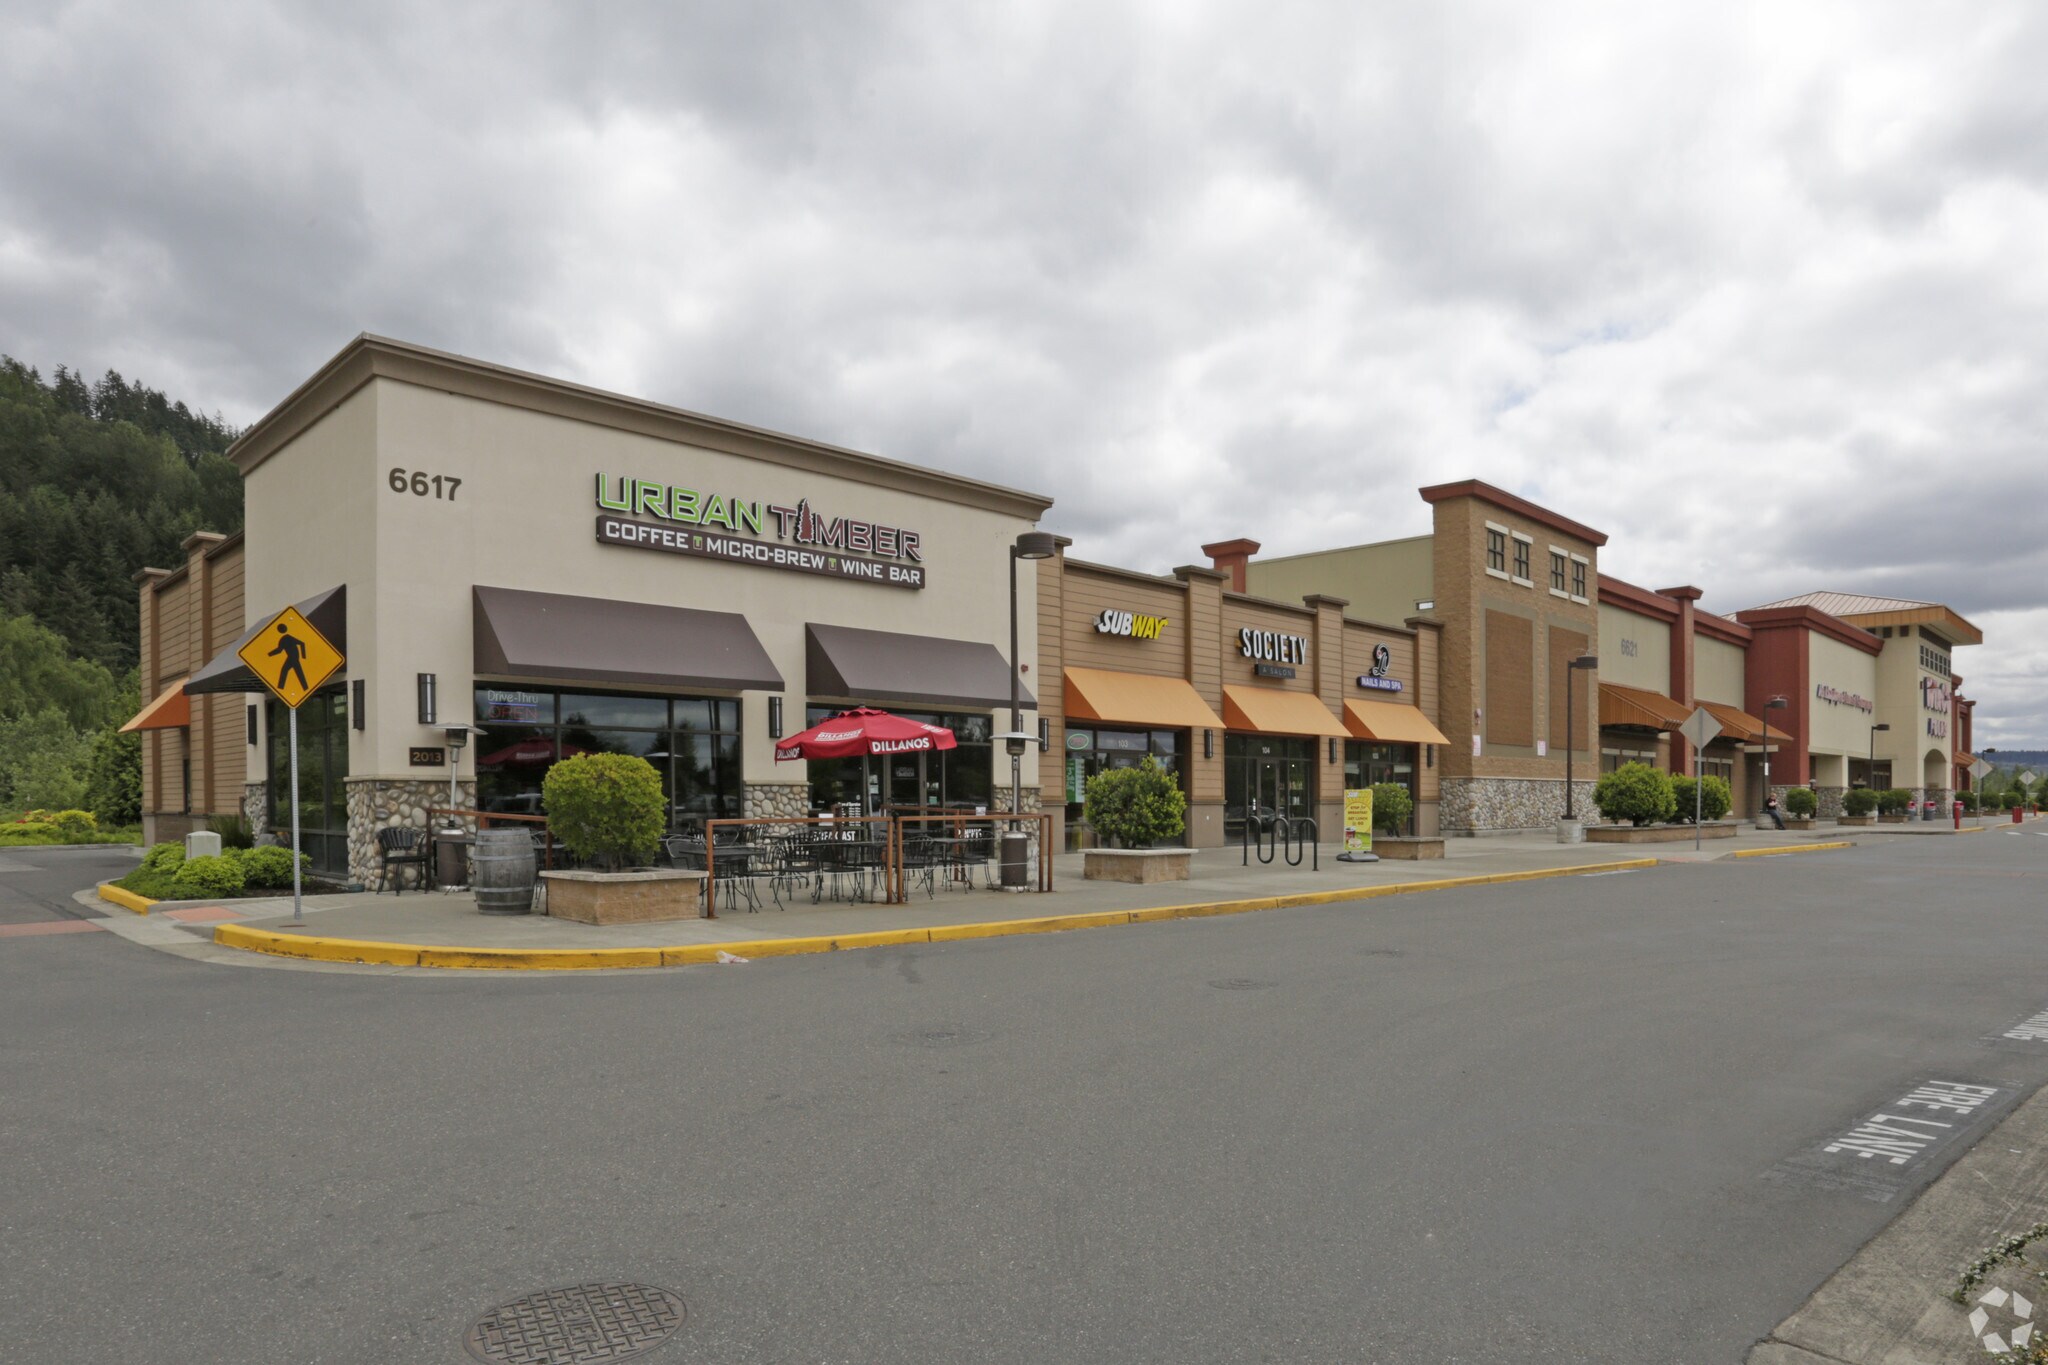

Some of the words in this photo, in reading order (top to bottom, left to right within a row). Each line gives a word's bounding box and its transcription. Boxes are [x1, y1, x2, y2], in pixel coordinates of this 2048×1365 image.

[388, 467, 462, 502] 6617
[596, 472, 763, 534] URBAN
[605, 521, 689, 549] COFFEE
[706, 536, 825, 570] MICRO-BREW
[840, 558, 883, 579] WINE
[889, 566, 921, 585] BAR
[1095, 608, 1169, 640] SUBWAY
[1240, 627, 1307, 665] SOCIETY
[1620, 637, 1638, 658] 6621
[1361, 676, 1379, 688] NAILS
[1379, 679, 1391, 689] AND
[1391, 680, 1402, 691] SPA
[487, 689, 539, 704] Drive-Thru
[488, 705, 539, 721] OPEN
[871, 738, 930, 752] DILLANOS
[1118, 739, 1129, 748] 103
[1262, 746, 1271, 754] 104
[412, 751, 442, 762] 2013
[1896, 1080, 1998, 1115] FIRE
[1823, 1113, 1953, 1165] LANE
